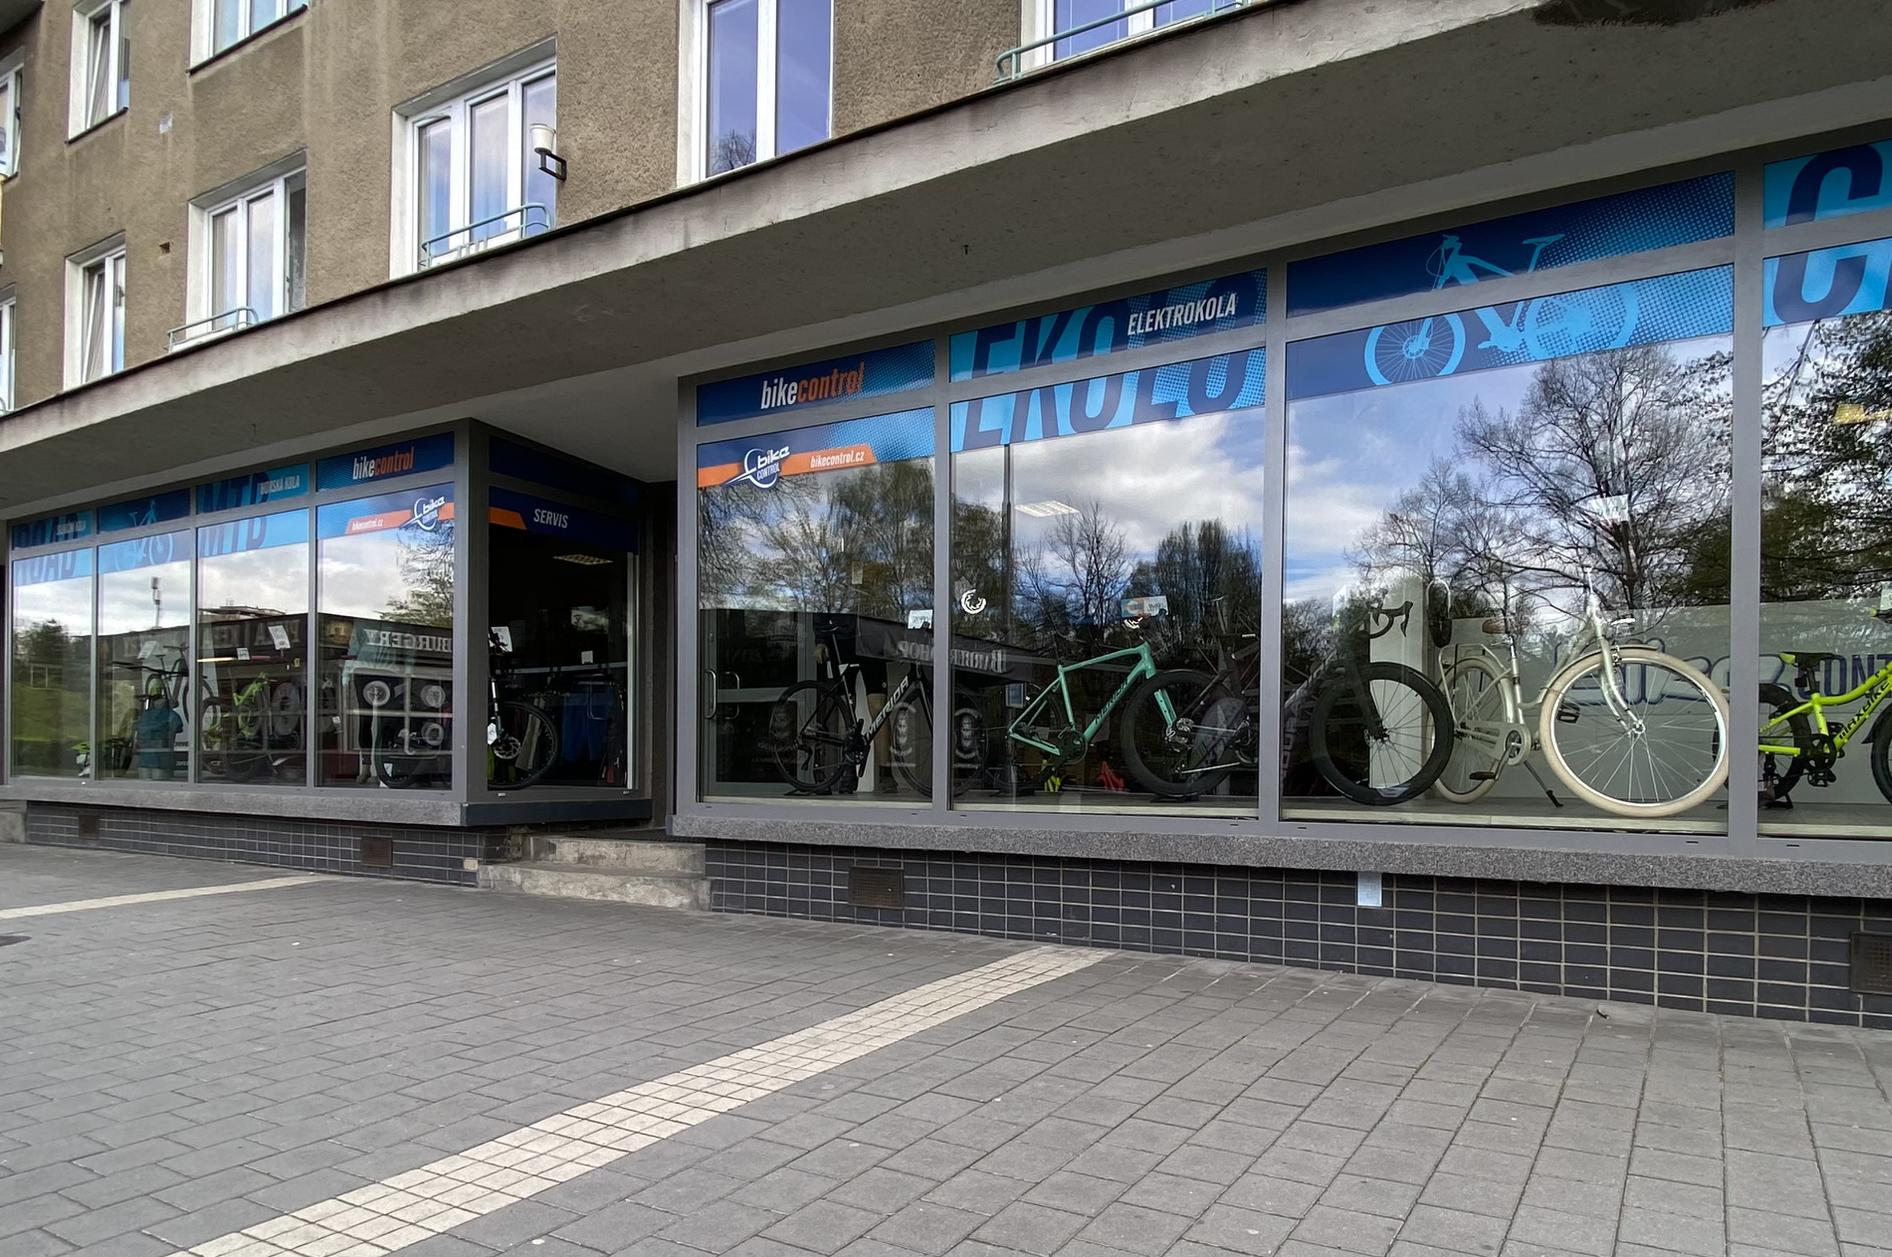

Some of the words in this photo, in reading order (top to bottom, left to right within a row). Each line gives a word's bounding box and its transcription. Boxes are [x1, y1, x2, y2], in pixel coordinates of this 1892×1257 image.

[1127, 292, 1238, 337] ELEKTROKOLA
[961, 270, 1258, 451] EKOLO
[760, 361, 865, 410] bikecontrol
[352, 446, 415, 480] bikecontrol
[810, 450, 865, 469] bikecontrol.cz
[533, 508, 569, 529] SERVIS
